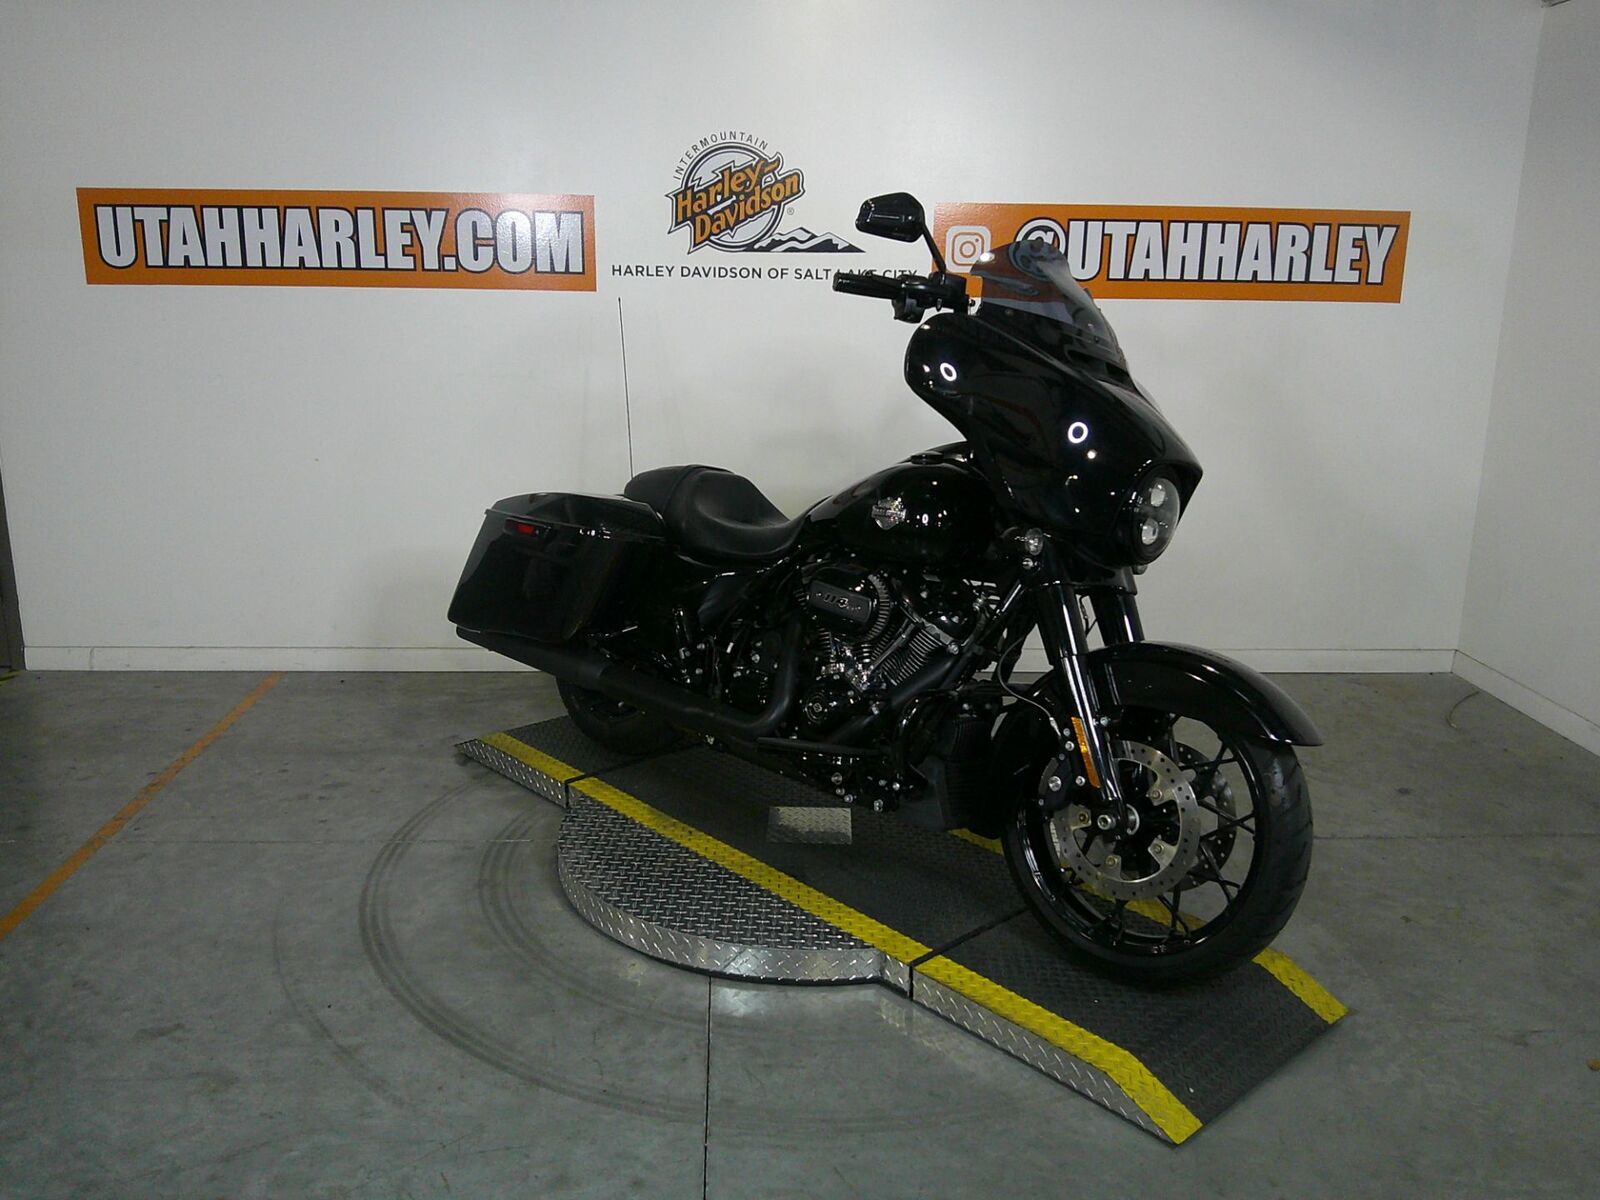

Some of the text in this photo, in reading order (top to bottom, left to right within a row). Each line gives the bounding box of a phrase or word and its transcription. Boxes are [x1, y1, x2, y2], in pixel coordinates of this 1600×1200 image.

[673, 131, 768, 180] INTERMOUNTAIN
[94, 203, 585, 275] UTAHHARLEY.COM
[693, 173, 800, 245] Davidson
[611, 265, 675, 278] HARLEY
[680, 266, 763, 280] DAVIDSON
[767, 268, 789, 280] OF
[794, 268, 832, 280] SALT
[1008, 217, 1400, 286] @UTAHHARLEY
